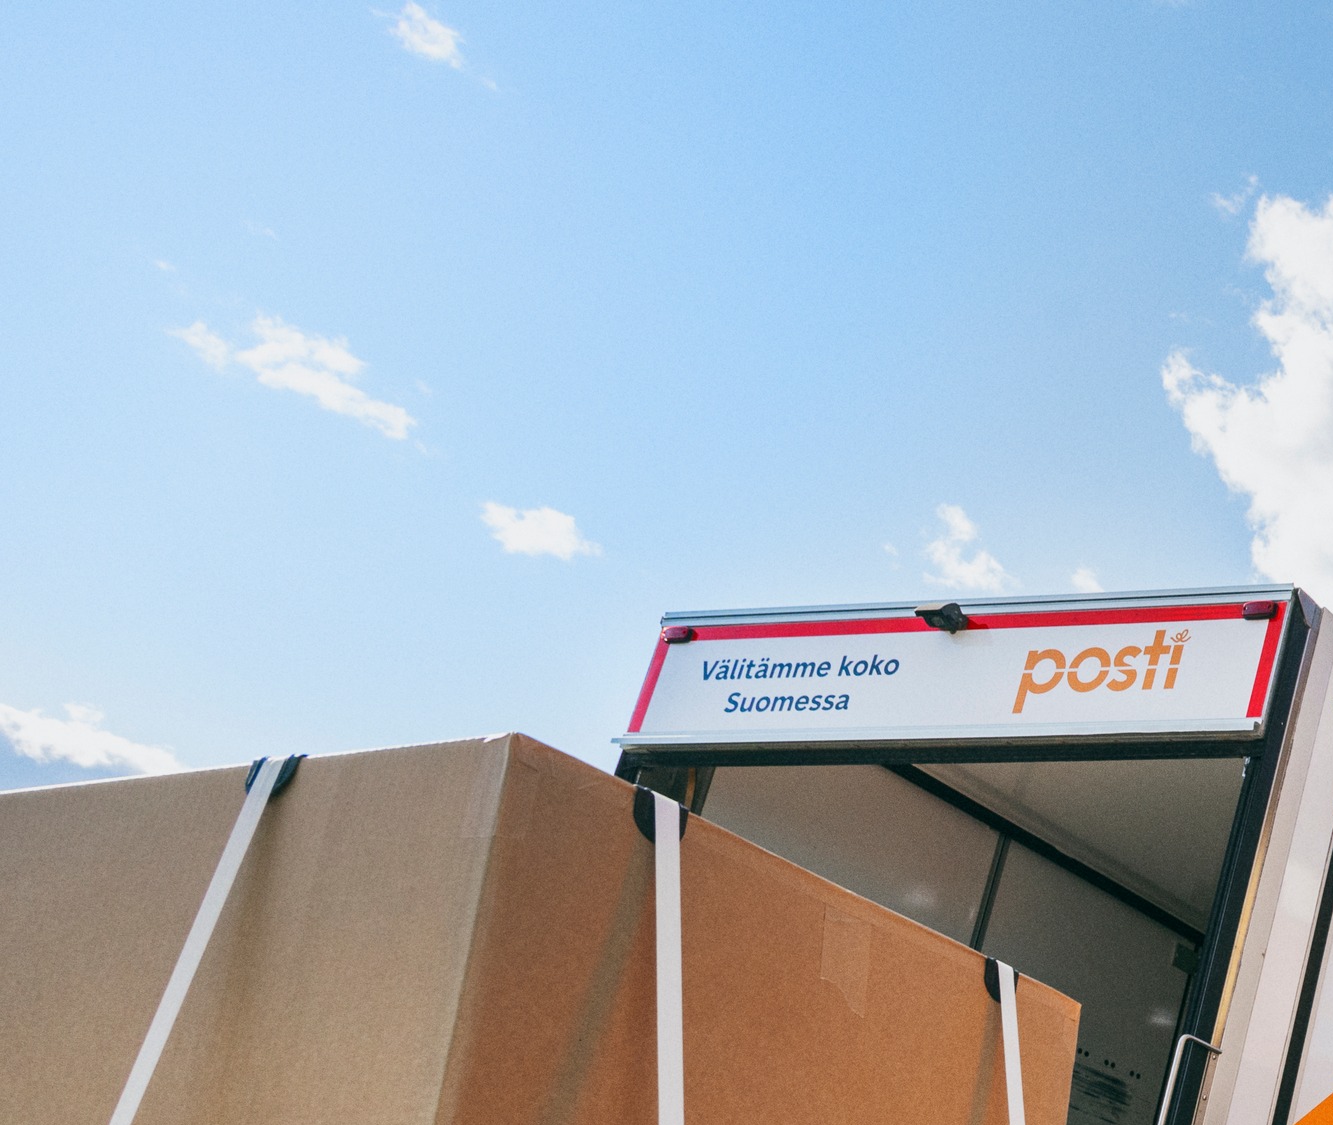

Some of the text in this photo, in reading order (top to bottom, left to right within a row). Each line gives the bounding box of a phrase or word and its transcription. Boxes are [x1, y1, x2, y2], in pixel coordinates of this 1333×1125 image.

[703, 654, 900, 681] Välitämme koko
[1012, 629, 1191, 714] posti
[724, 692, 850, 713] Suomessa
